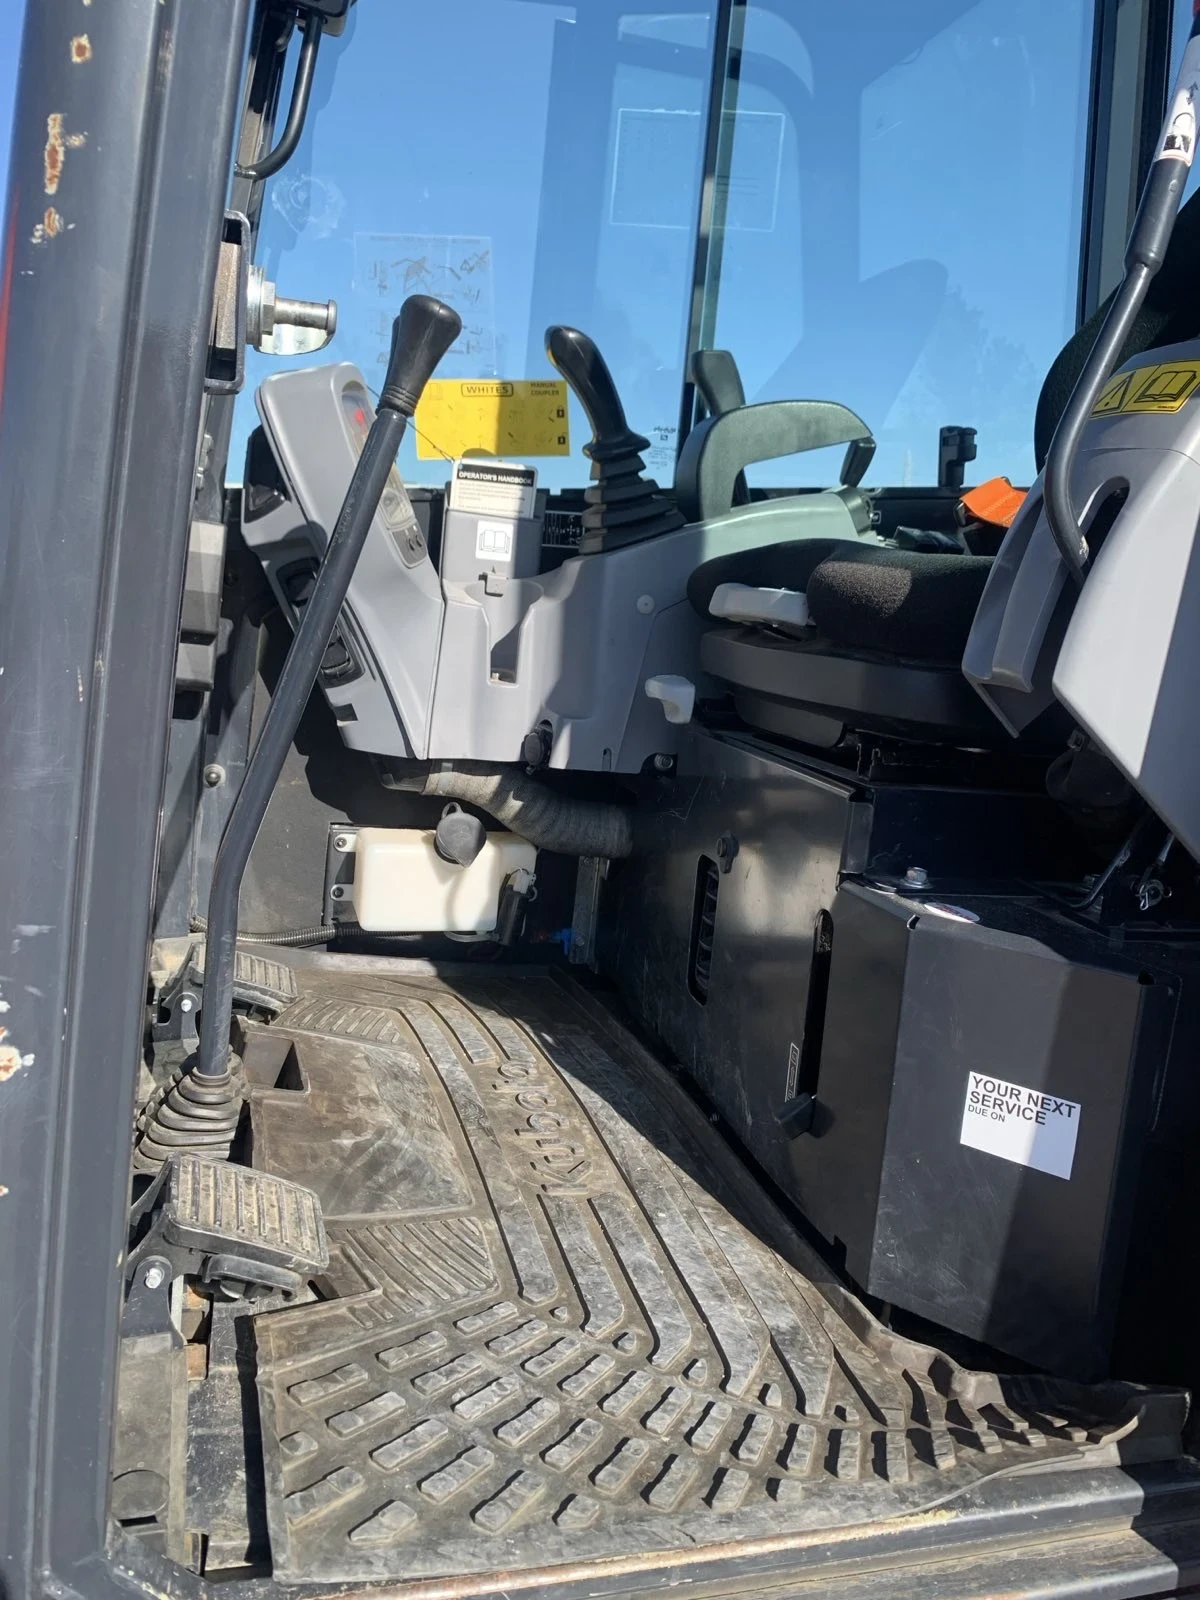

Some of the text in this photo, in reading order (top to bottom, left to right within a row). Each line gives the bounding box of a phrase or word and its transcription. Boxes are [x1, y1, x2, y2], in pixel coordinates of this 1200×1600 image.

[466, 386, 509, 394] WHITES
[458, 471, 532, 485] OPERATOR'S HANDBOOK
[969, 1090, 1047, 1126] SERVICE
[973, 1075, 1076, 1118] YOUR NEXT
[967, 1104, 1006, 1122] DUE ON
[491, 1062, 593, 1196] Kubota
